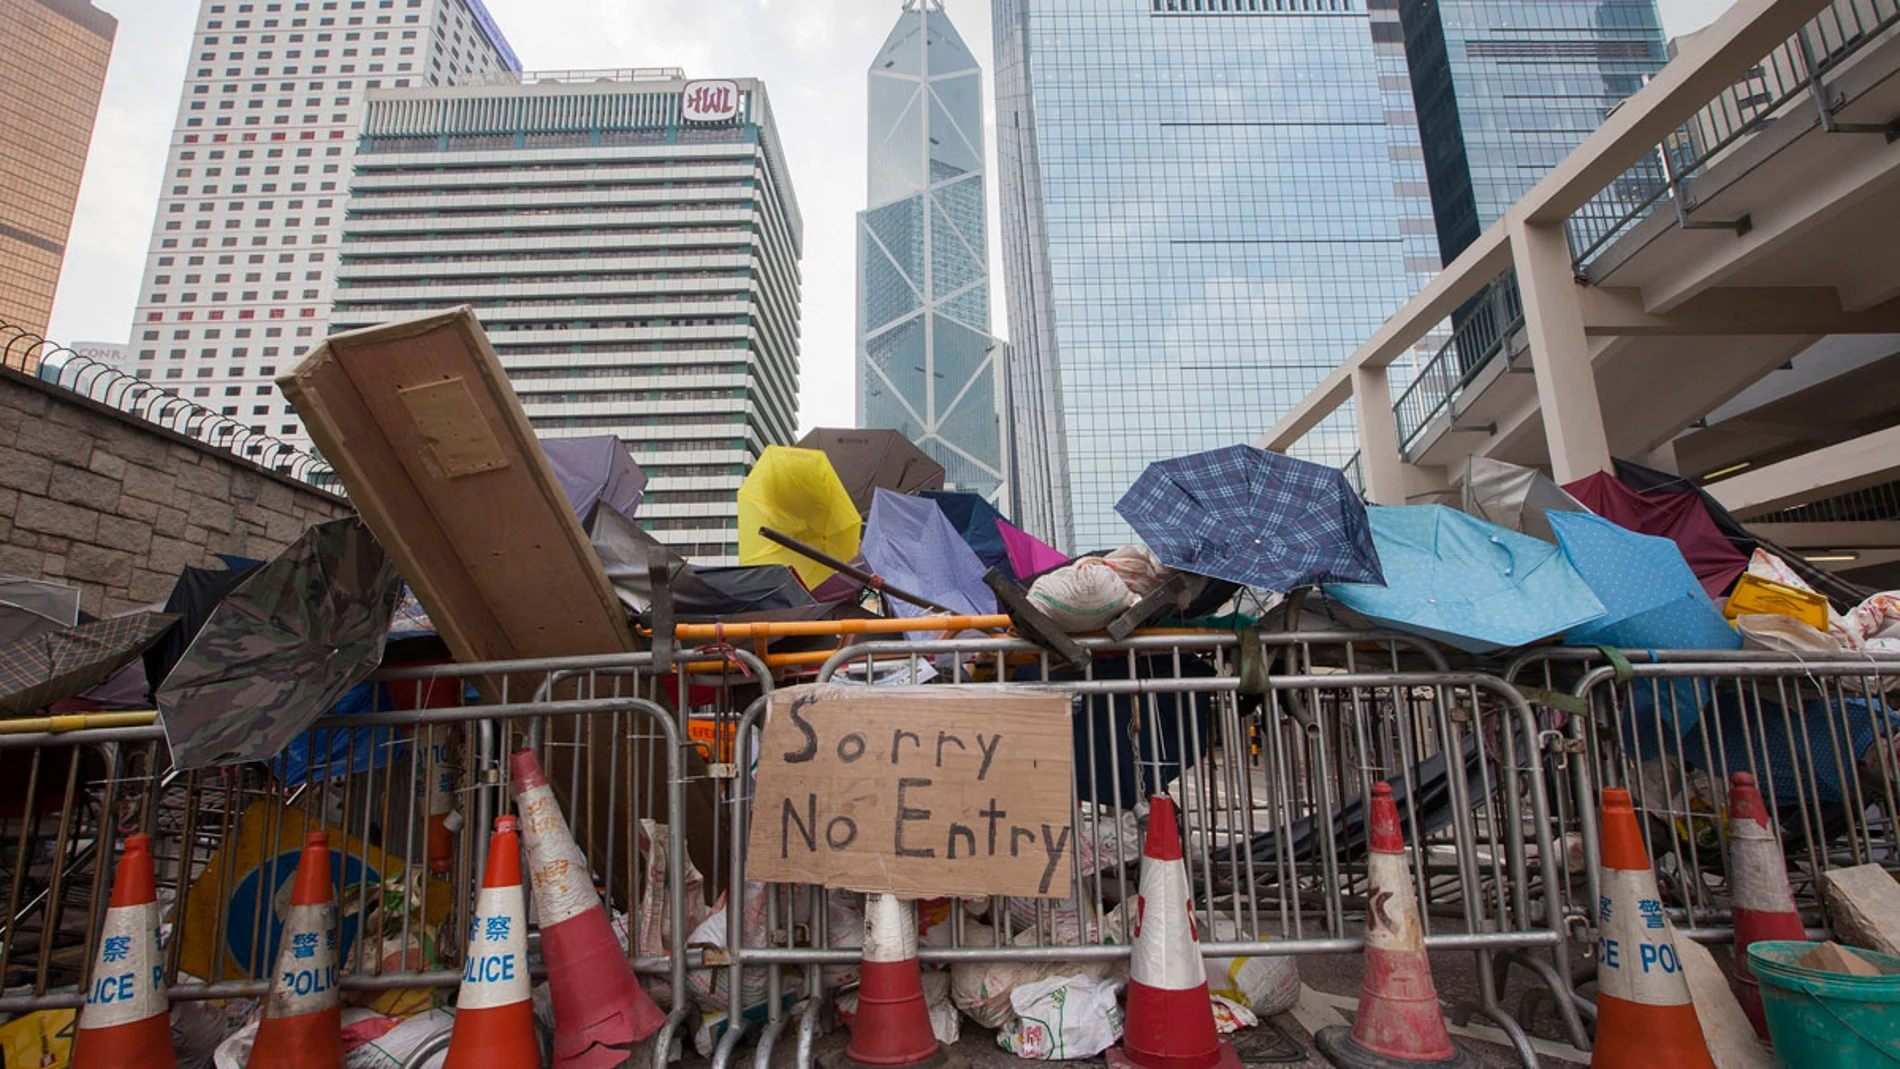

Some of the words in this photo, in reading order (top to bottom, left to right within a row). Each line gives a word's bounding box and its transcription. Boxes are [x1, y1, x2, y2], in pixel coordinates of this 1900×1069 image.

[79, 347, 127, 360] CONR
[784, 695, 1001, 780] Sorry
[781, 793, 857, 859] No
[894, 778, 1070, 893] Entry
